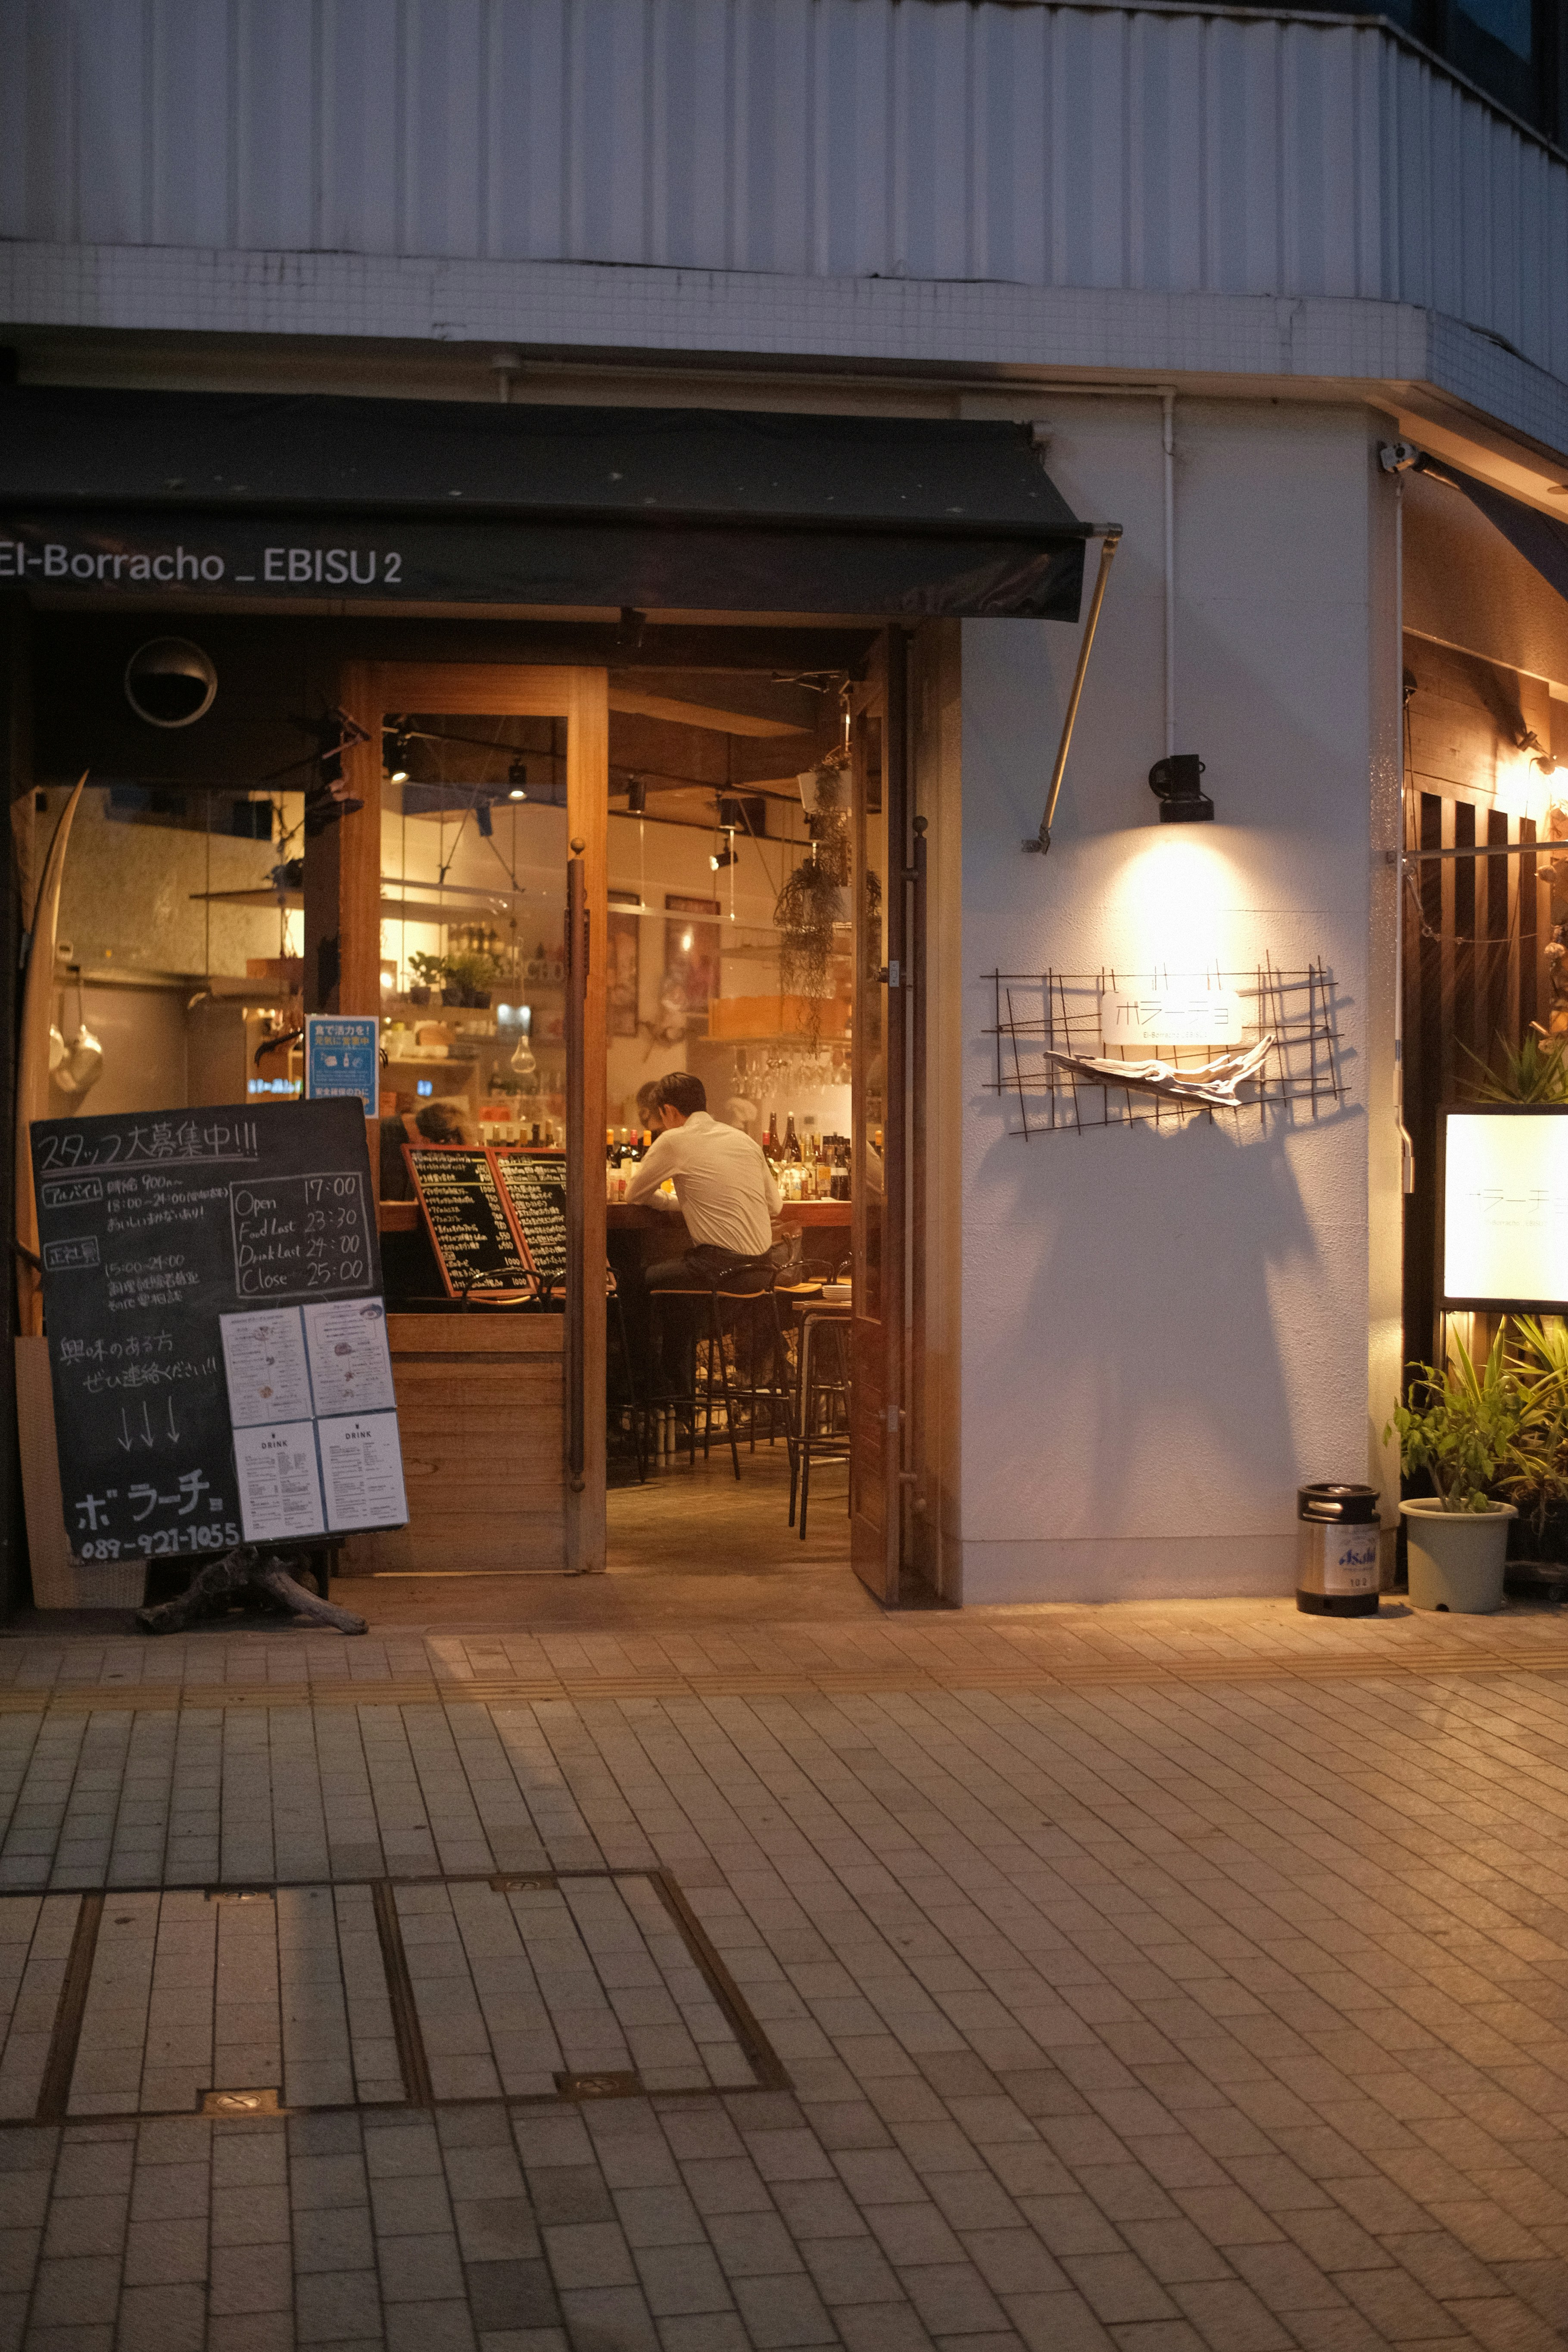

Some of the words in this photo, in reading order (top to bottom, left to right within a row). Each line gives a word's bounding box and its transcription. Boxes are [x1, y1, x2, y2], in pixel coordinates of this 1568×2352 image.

[235, 1190, 277, 1217] Open
[305, 1177, 356, 1205] 17:00
[239, 1218, 268, 1242] Food
[271, 1218, 296, 1235] Last
[304, 1207, 357, 1233] 23:30
[239, 1244, 274, 1268] Drink
[277, 1243, 301, 1258] Last
[305, 1234, 360, 1258] 24:00
[242, 1267, 287, 1293] Close
[307, 1260, 363, 1287] 25:00
[59, 1329, 173, 1366] 興味のある方
[261, 1440, 288, 1450] DRINK
[345, 1431, 372, 1440] DRINK
[81, 1522, 240, 1560] 089-921-1055
